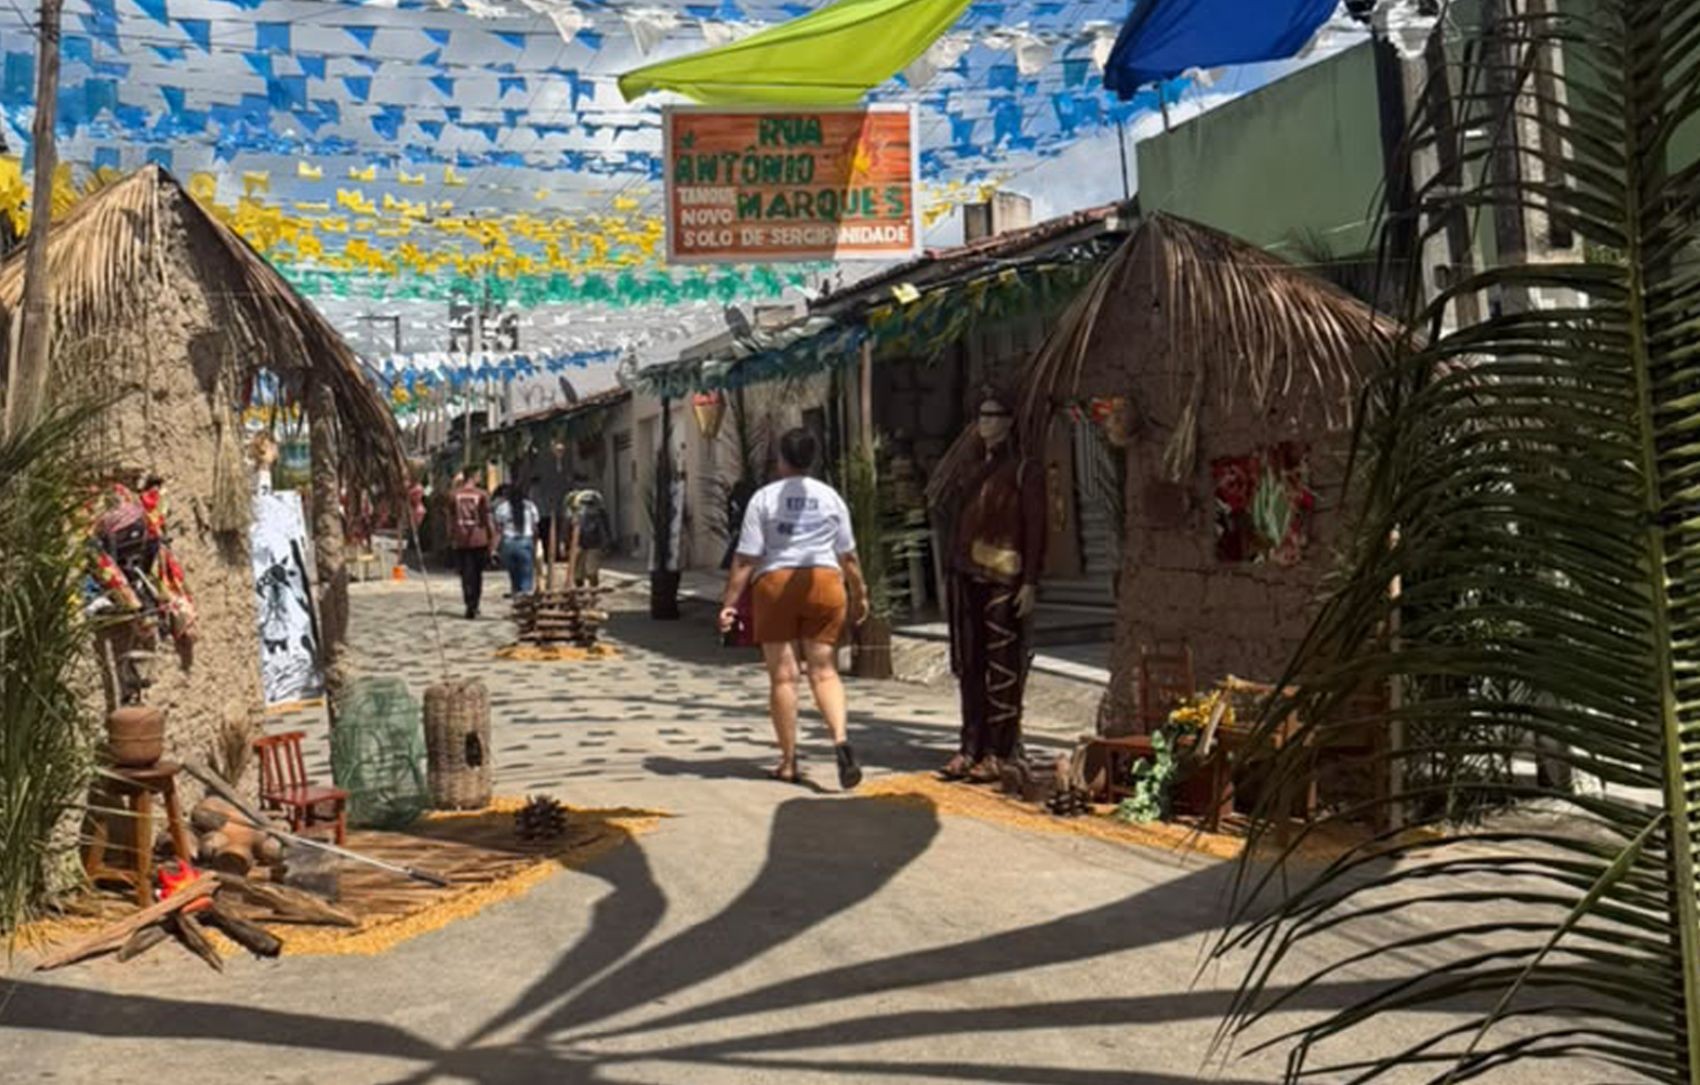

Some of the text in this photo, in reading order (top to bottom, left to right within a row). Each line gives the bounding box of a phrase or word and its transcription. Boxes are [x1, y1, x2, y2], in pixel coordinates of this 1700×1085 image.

[759, 118, 823, 146] RUA
[674, 145, 815, 184] ANTÔNIO
[681, 208, 733, 225] NOVO
[737, 186, 905, 220] MARQUES
[683, 229, 733, 248] SOLO
[741, 227, 766, 246] DE
